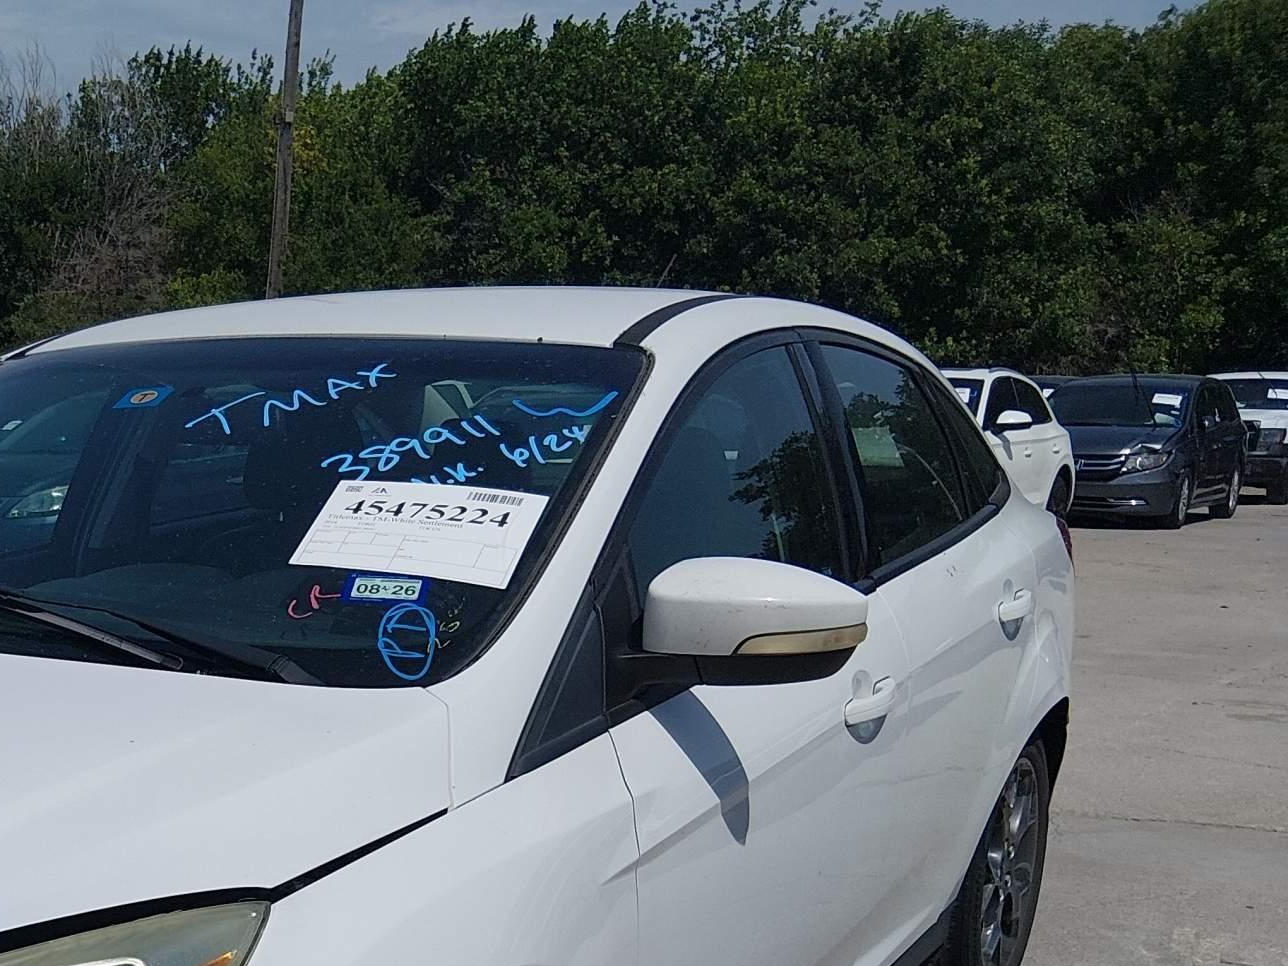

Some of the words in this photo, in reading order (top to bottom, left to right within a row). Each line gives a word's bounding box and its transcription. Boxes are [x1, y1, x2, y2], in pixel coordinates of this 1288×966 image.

[320, 414, 501, 481] 389911
[344, 498, 512, 528] 45475224
[356, 583, 381, 595] 08
[391, 584, 416, 596] 26
